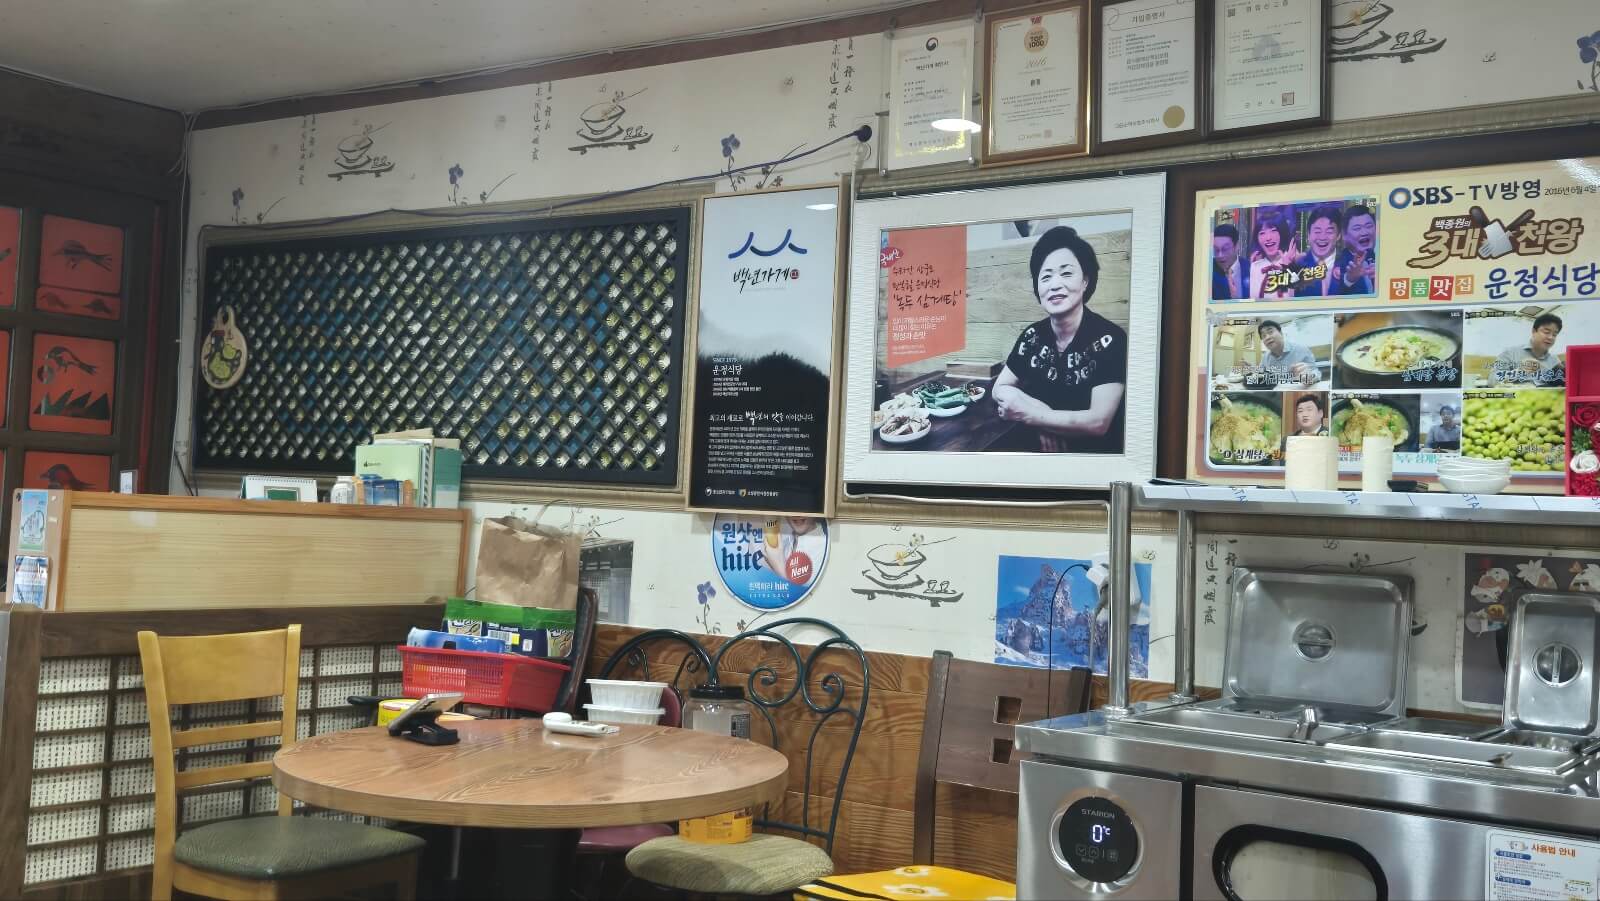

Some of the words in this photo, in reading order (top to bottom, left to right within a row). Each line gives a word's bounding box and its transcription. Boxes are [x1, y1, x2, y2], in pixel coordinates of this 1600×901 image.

[1028, 41, 1045, 49] 1000
[1434, 218, 1472, 230] 백종원의
[1407, 226, 1481, 269] 3대
[1516, 218, 1584, 255] 천왕
[733, 266, 791, 293] 백년가게
[1264, 272, 1289, 292] 3대
[1302, 264, 1328, 281] 천왕
[1390, 276, 1474, 299] 명품맛집
[1484, 262, 1600, 300] 운정식당
[892, 332, 912, 341] 정성과
[713, 364, 742, 375] 운정식당
[721, 522, 763, 544] 원샷엔
[721, 545, 765, 571] hite
[789, 557, 800, 567] All
[791, 565, 809, 577] New
[1081, 808, 1116, 819] STARION
[1531, 843, 1556, 855] 사용법
[1558, 847, 1576, 858] 안내
